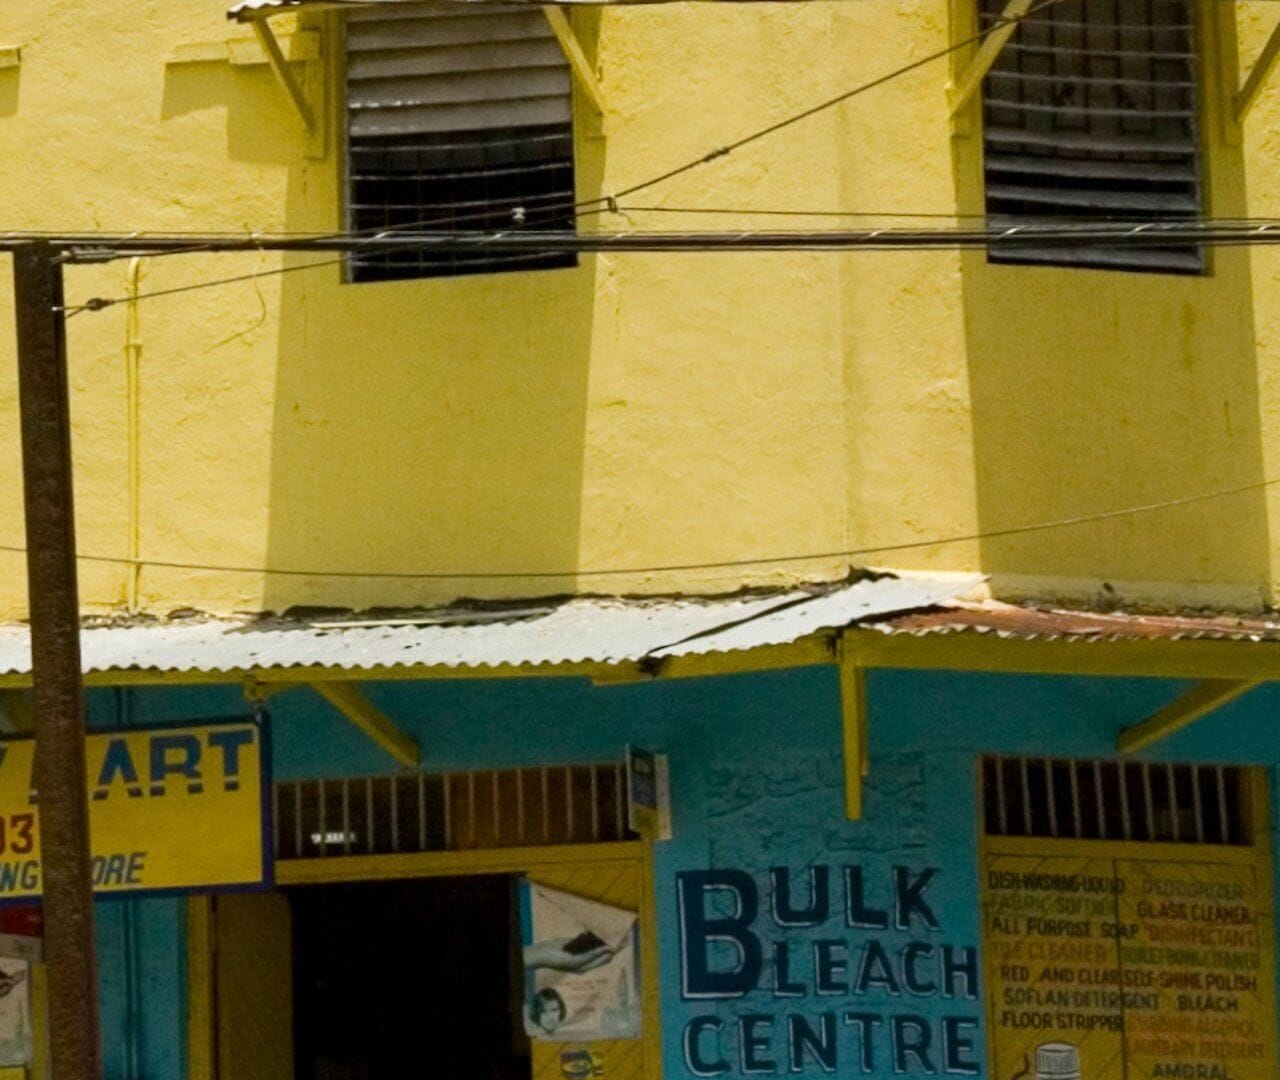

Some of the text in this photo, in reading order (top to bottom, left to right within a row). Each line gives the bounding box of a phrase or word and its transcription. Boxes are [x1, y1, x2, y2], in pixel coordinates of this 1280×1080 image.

[28, 730, 255, 805] ART
[92, 852, 148, 885] ORE
[1136, 900, 1251, 924] GLASS CLEANER
[676, 865, 942, 1000] BULK
[991, 916, 1139, 940] ALL PURPOSE SOAP
[1028, 942, 1106, 964] CLEANER
[1000, 965, 1030, 982] RED
[1039, 966, 1075, 984] AND
[1206, 974, 1258, 993] POLISH
[1177, 995, 1239, 1013] BLEACH
[1001, 1011, 1054, 1029] FLOOR
[1056, 1012, 1125, 1032] STRIPPER
[682, 1011, 981, 1078] CENTRE
